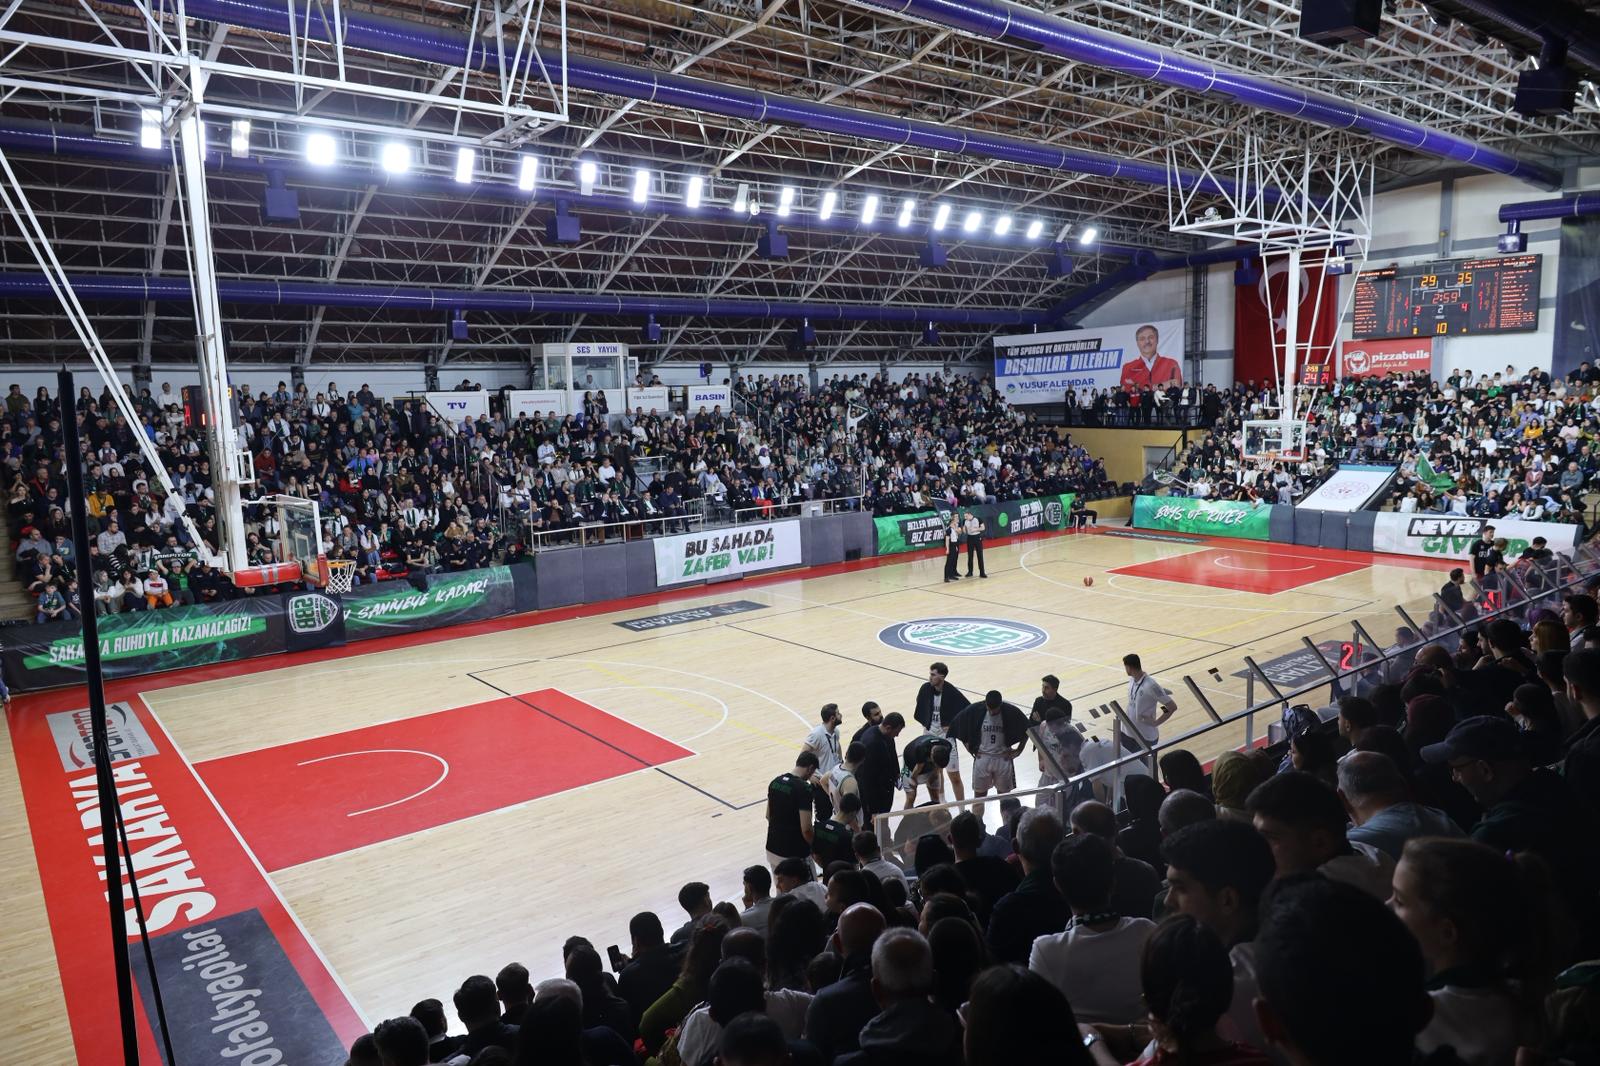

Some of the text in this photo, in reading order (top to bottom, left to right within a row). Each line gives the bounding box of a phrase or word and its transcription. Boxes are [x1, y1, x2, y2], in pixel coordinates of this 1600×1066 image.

[1421, 275, 1437, 288] 29
[1457, 272, 1473, 285] 35
[1432, 292, 1458, 304] 2:59
[1415, 305, 1422, 315] 2
[1437, 304, 1444, 314] 2
[1461, 303, 1469, 312] 4
[1436, 322, 1448, 334] 10
[576, 345, 618, 354] SES YAYIN
[1371, 349, 1430, 363] pizzabulls
[1303, 373, 1317, 384] 24
[1154, 505, 1247, 525] BOYS OF RIVER
[1411, 519, 1481, 536] NEVER
[685, 528, 774, 558] BU SAHADA
[682, 552, 731, 576] ZAFER
[358, 578, 488, 619] SANİYEYE KADAR!
[49, 642, 109, 663] SAKAA
[114, 633, 168, 654] RUHUYLA
[991, 734, 997, 744] 9
[69, 762, 216, 936] SAKARYA
[182, 928, 290, 1066] ofaltyapilar
